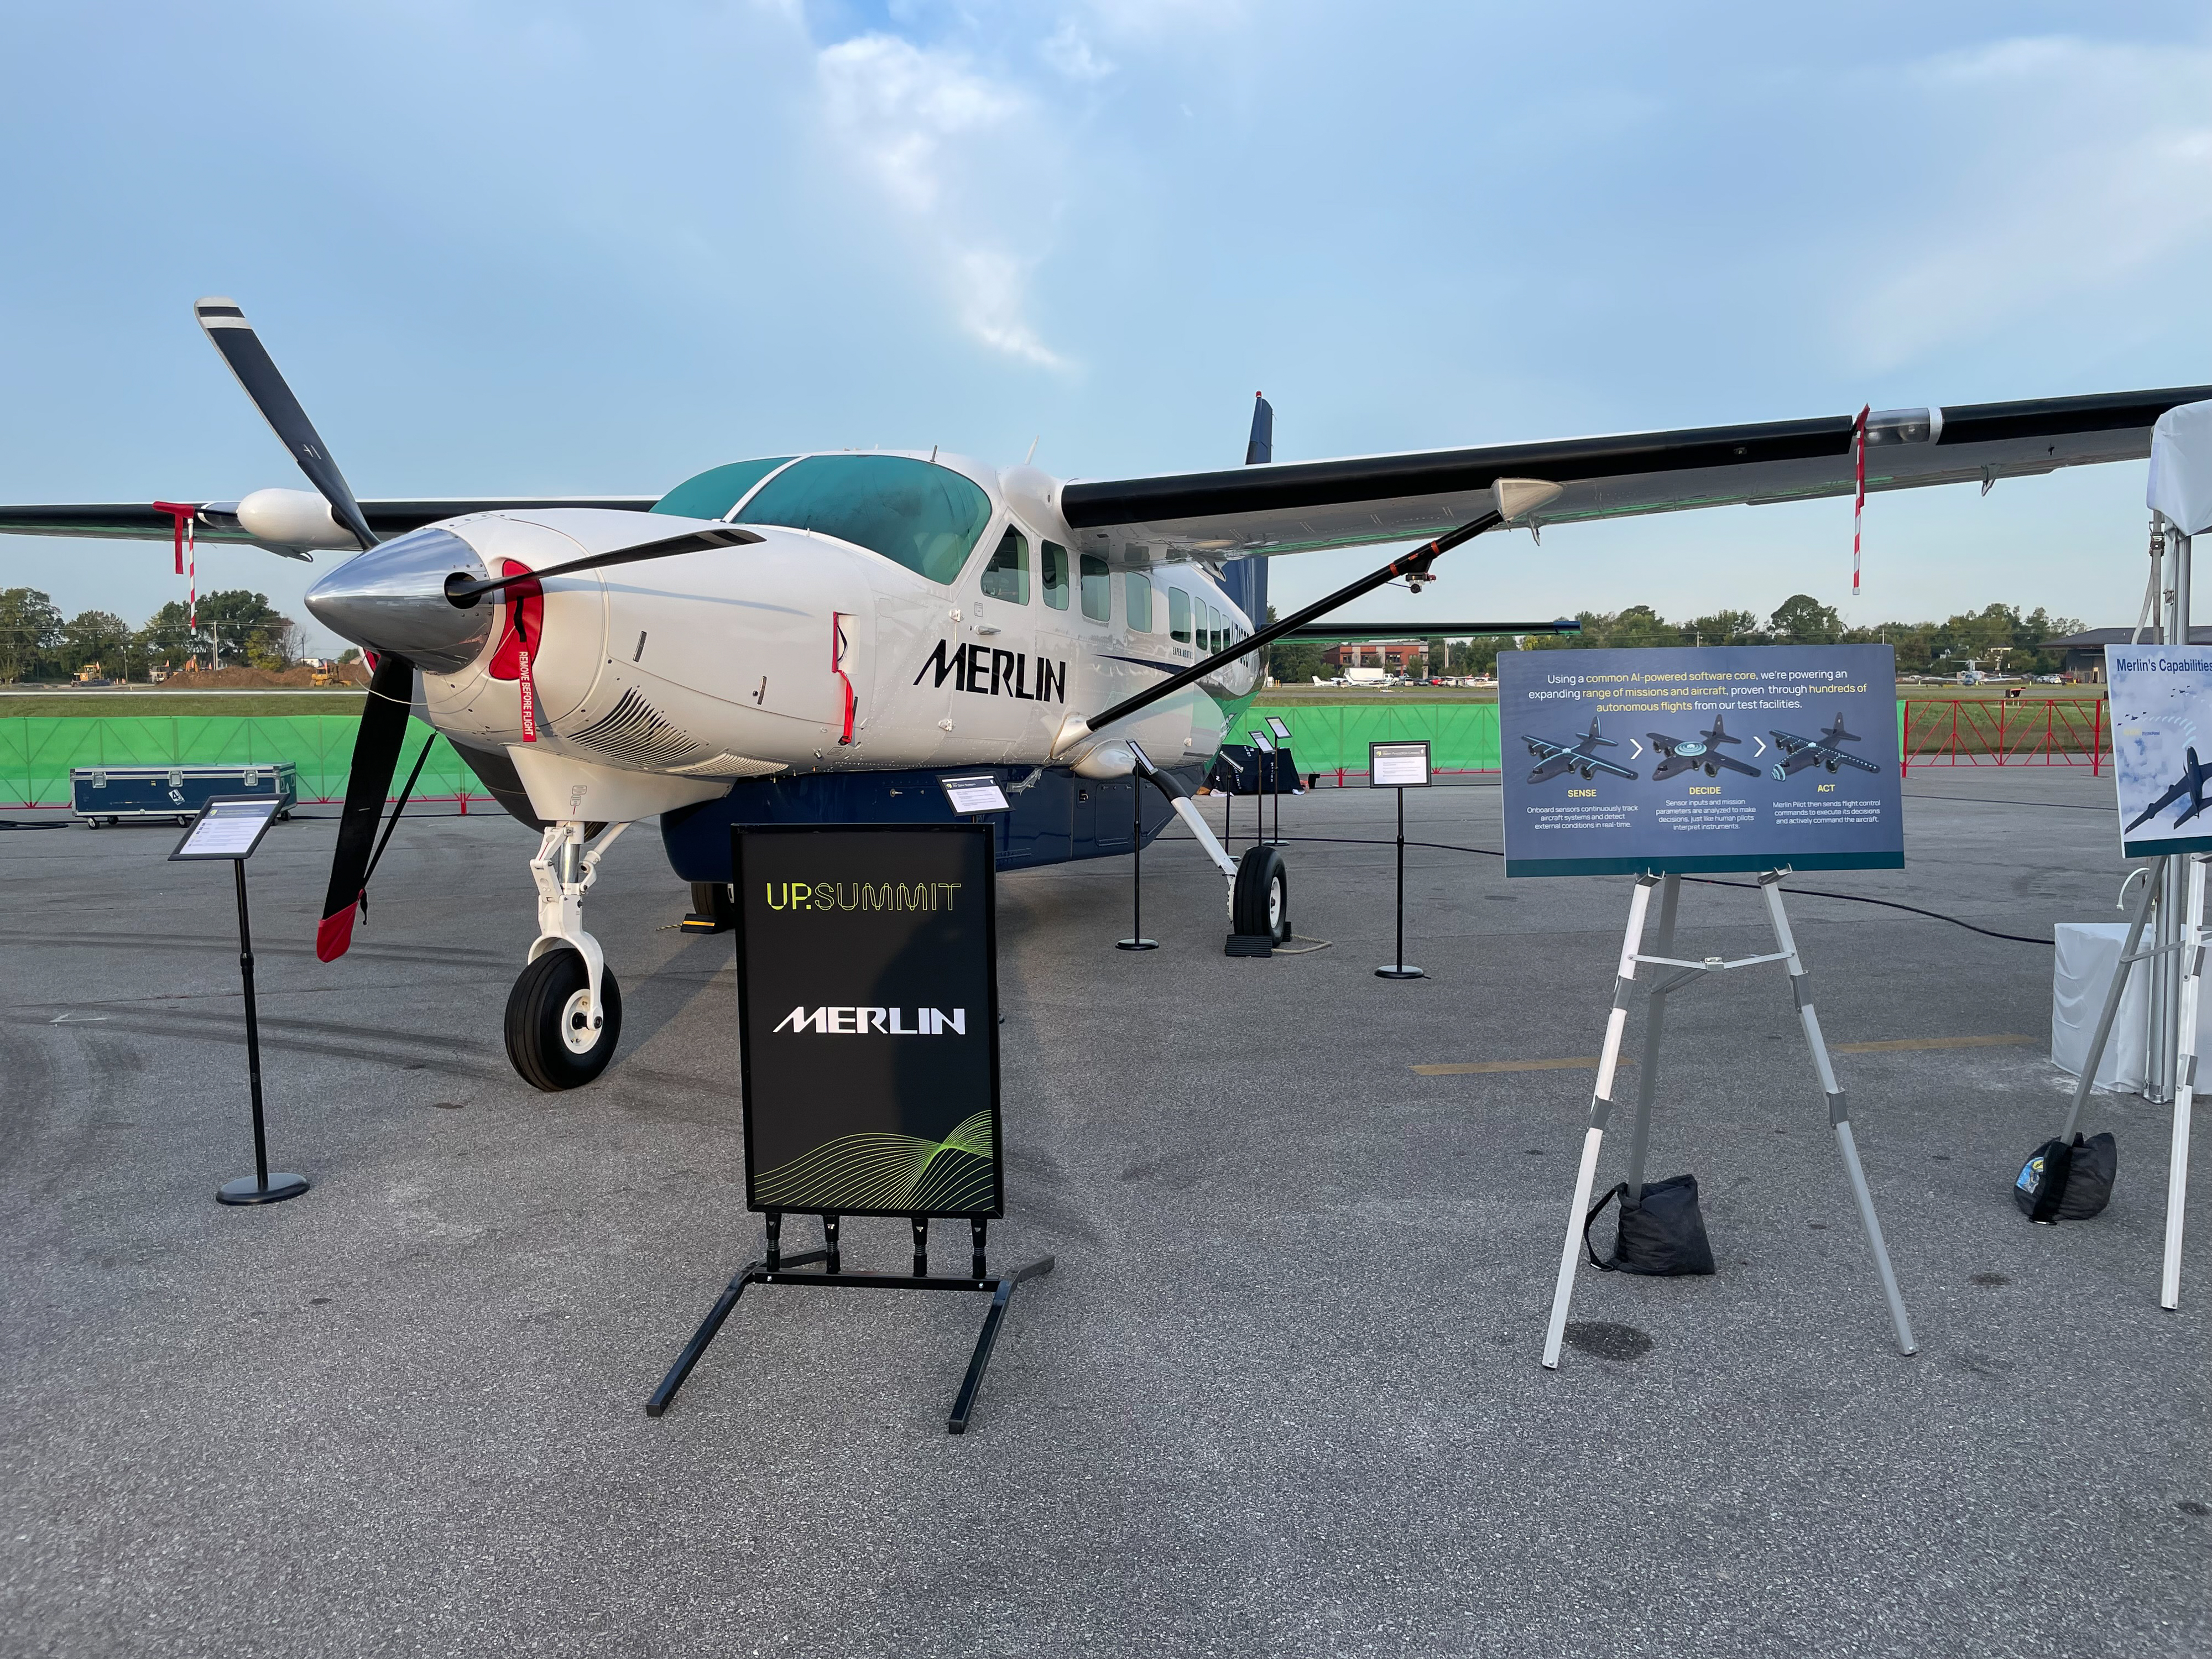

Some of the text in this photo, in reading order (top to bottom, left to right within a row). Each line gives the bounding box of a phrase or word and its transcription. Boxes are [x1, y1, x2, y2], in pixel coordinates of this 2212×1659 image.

[913, 639, 1066, 704] MERLIN
[2117, 659, 2156, 671] Merlin's
[1548, 675, 1576, 686] Using
[1631, 672, 1687, 684] AI-powered
[1689, 672, 1732, 681] software
[1734, 672, 1759, 681] core,
[1761, 670, 1787, 680] we're
[1788, 670, 1833, 681] powering
[1835, 670, 1848, 679] an
[519, 651, 533, 736] REMOVE BEFORE FLIGHT
[1528, 684, 1867, 701] expanding range of missions and aircraft, proven through hundreds of
[1596, 703, 1658, 712] autonomous
[1661, 702, 1692, 713] flights
[1694, 701, 1717, 710] from
[1737, 701, 1757, 709] test
[1759, 700, 1802, 709] facilities.
[173, 791, 179, 800] 4
[1568, 789, 1597, 797] SENSE
[1689, 786, 1721, 795] DECIDE
[766, 883, 961, 911] UP.SUMMIT
[773, 1006, 965, 1035] MERLIN
